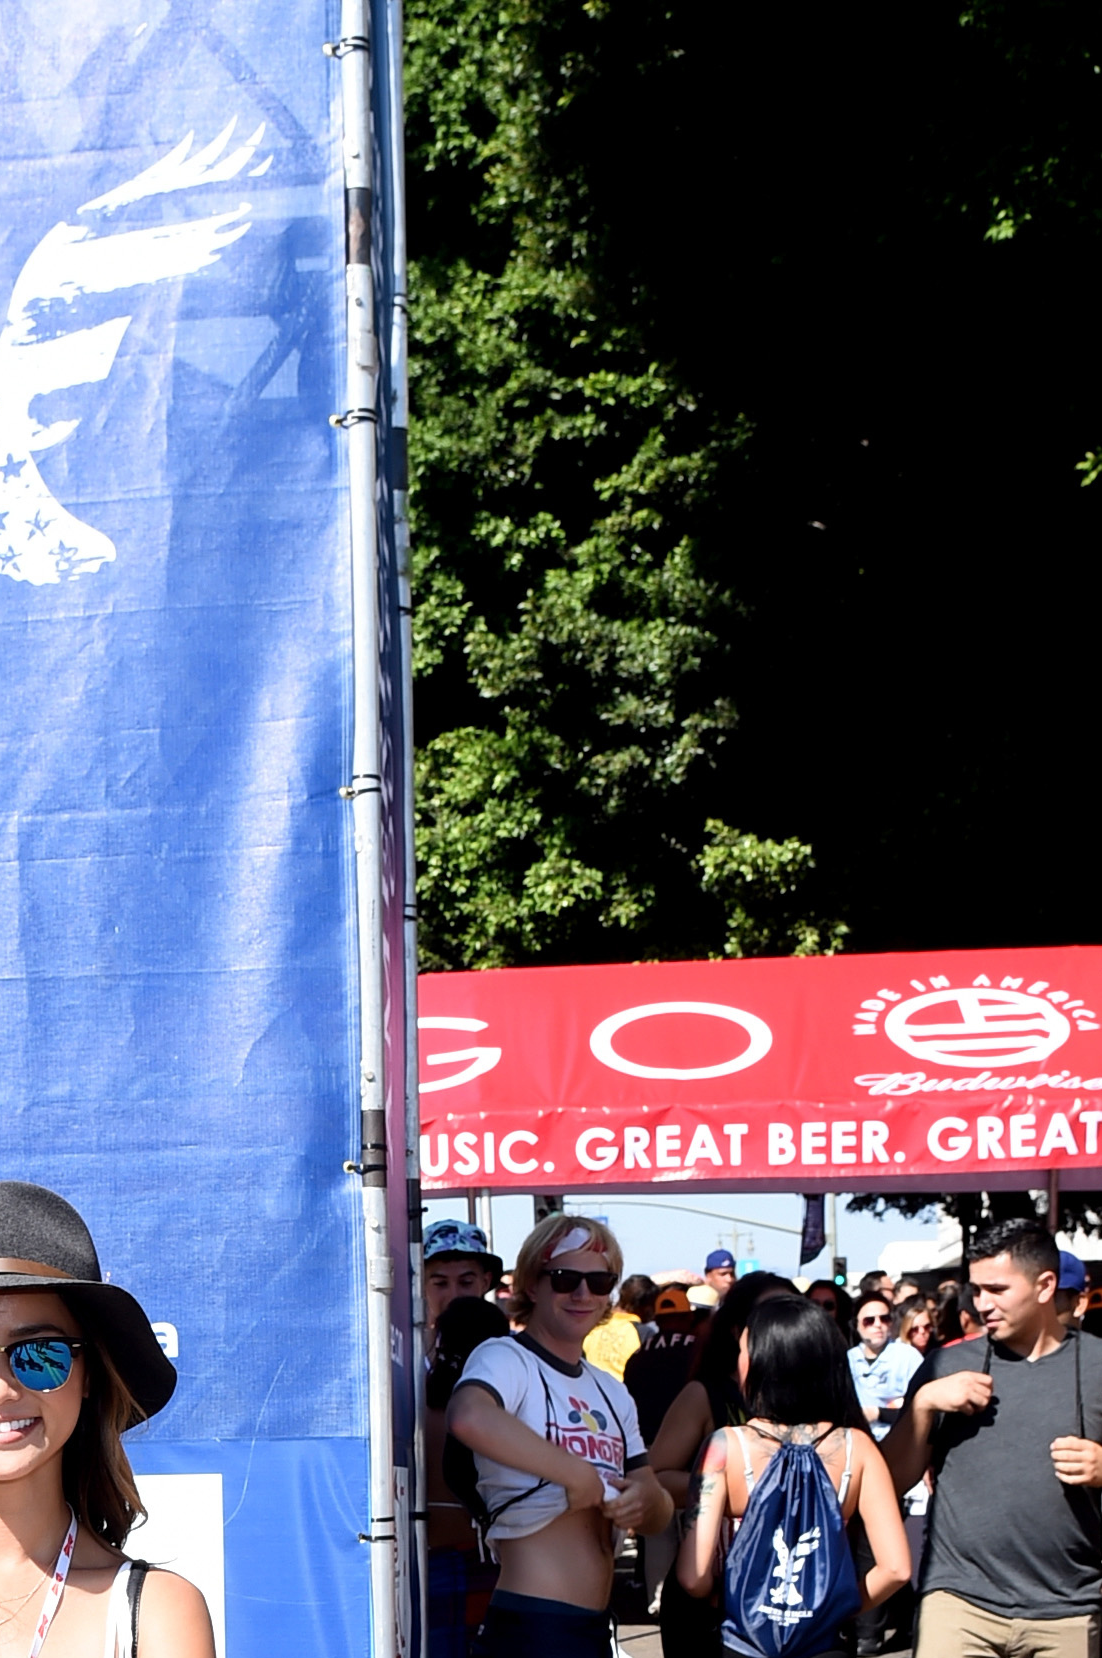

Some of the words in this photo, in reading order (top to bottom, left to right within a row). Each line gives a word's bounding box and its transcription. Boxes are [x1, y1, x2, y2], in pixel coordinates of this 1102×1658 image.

[852, 989, 902, 1035] MADE
[909, 974, 950, 993] IN
[972, 973, 1100, 1031] AMERICA
[575, 1123, 748, 1171] GREAT
[768, 1120, 906, 1165] BEER.
[927, 1111, 1102, 1162] GREAT
